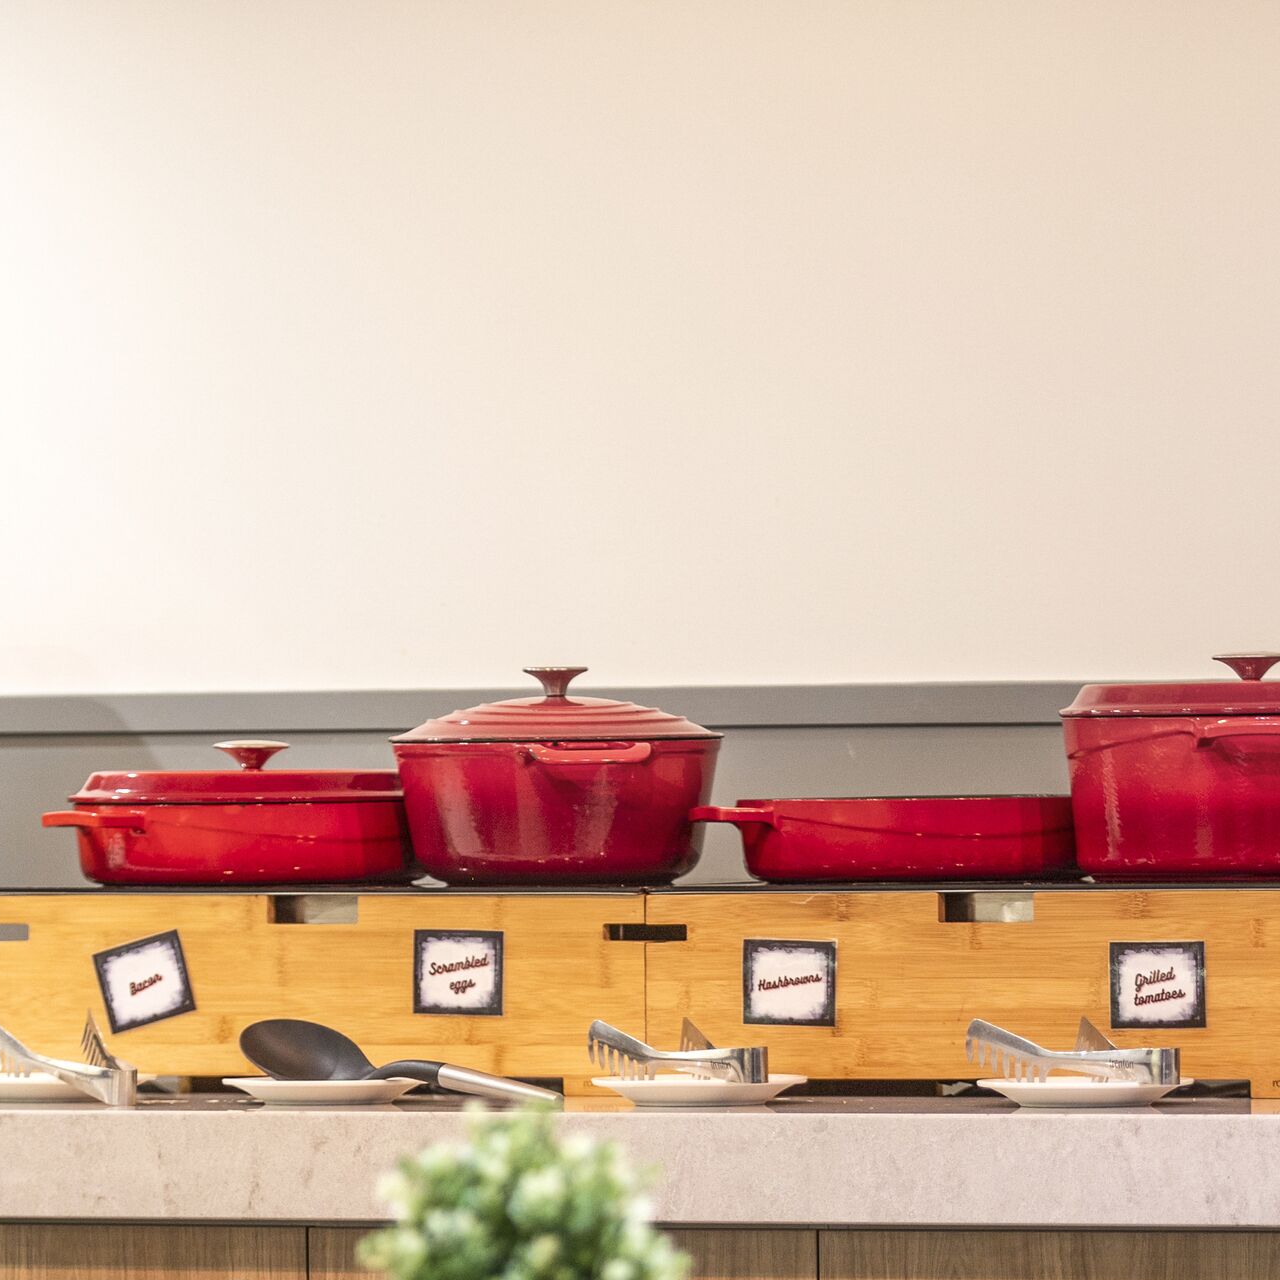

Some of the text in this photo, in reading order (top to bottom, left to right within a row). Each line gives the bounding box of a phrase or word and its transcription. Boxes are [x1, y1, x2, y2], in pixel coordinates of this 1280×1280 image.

[428, 953, 489, 976] Scrambled
[129, 973, 163, 996] Bacon
[449, 979, 476, 995] eggs
[758, 973, 822, 992] Hashbrowns
[1134, 966, 1176, 992] Grilled
[1134, 988, 1186, 1006] tomatoes
